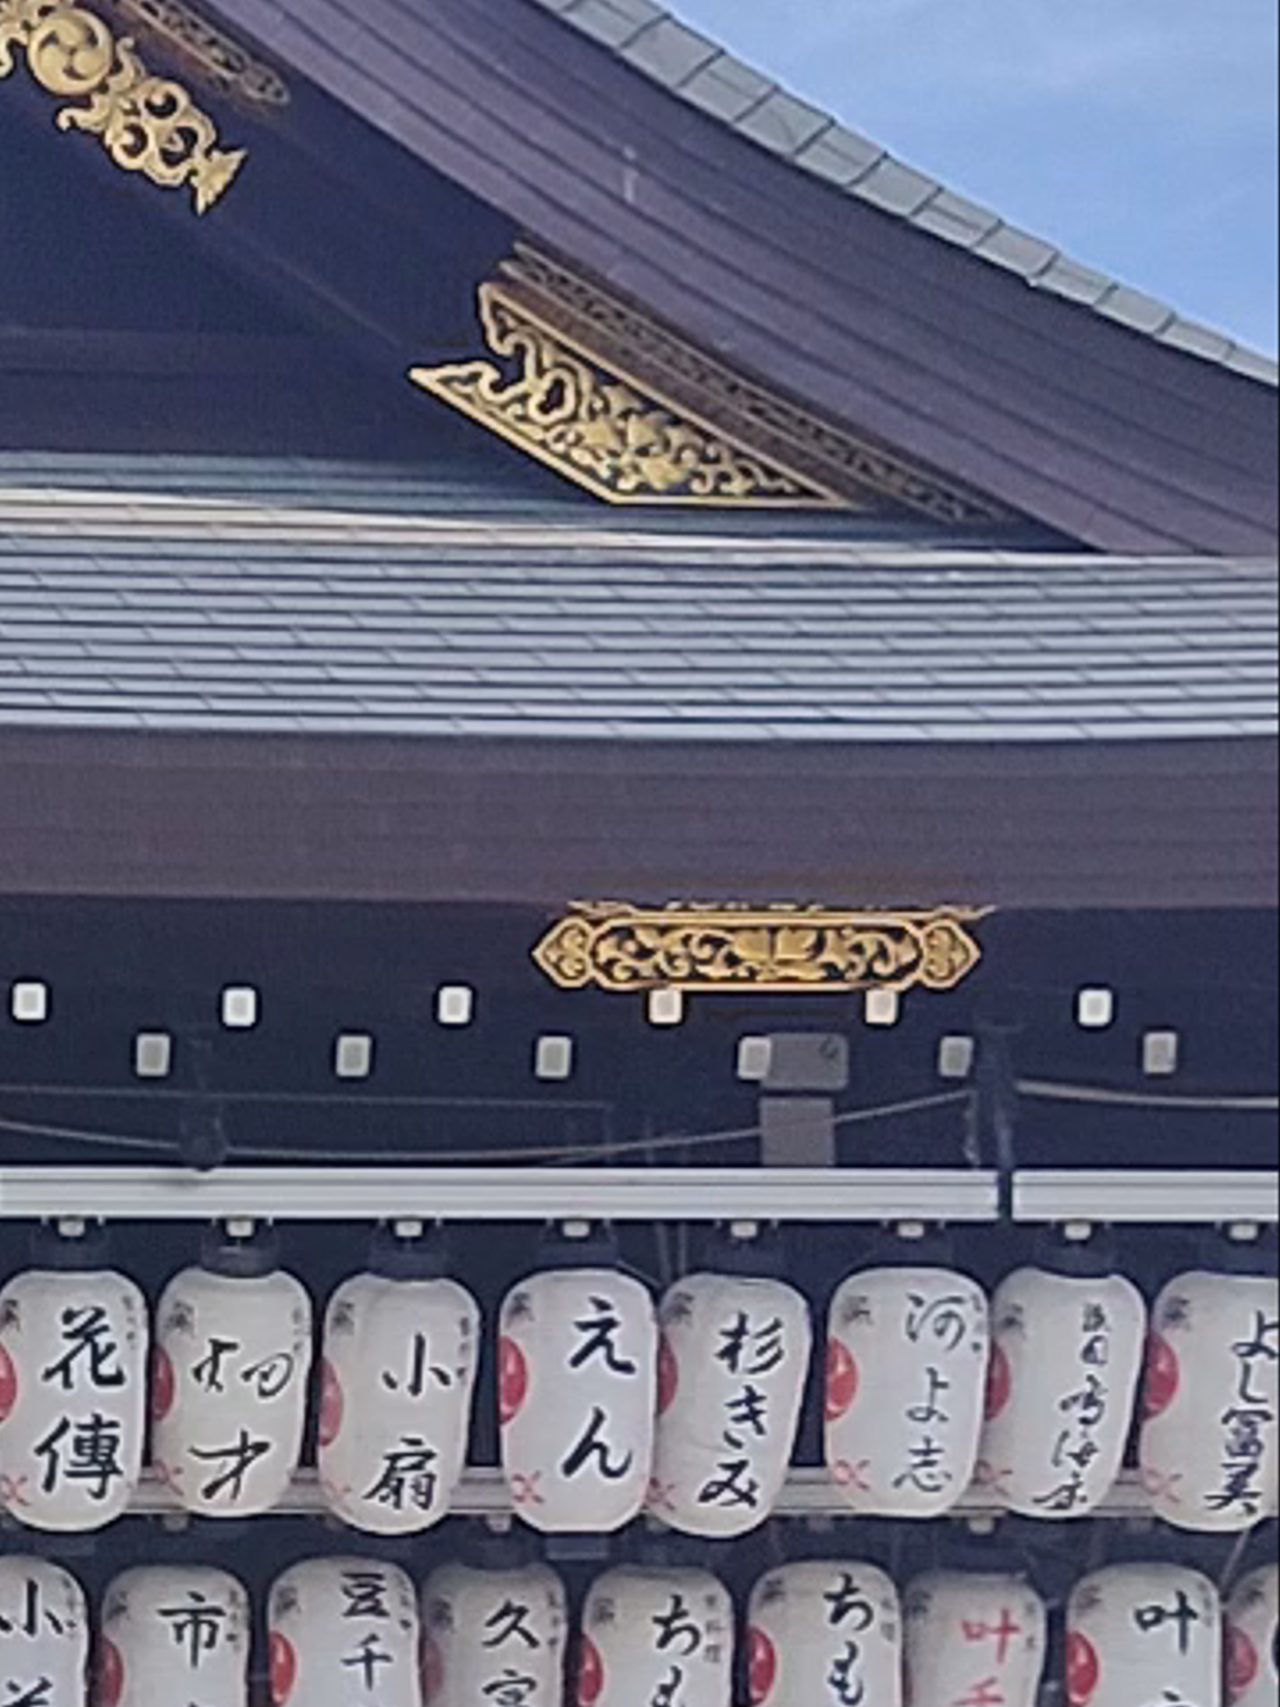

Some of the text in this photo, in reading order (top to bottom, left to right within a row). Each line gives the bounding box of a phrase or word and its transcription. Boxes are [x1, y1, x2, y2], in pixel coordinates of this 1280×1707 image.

[362, 1333, 456, 1511] 小扇
[561, 1296, 638, 1479] えん
[696, 1311, 788, 1509] 杉きみ
